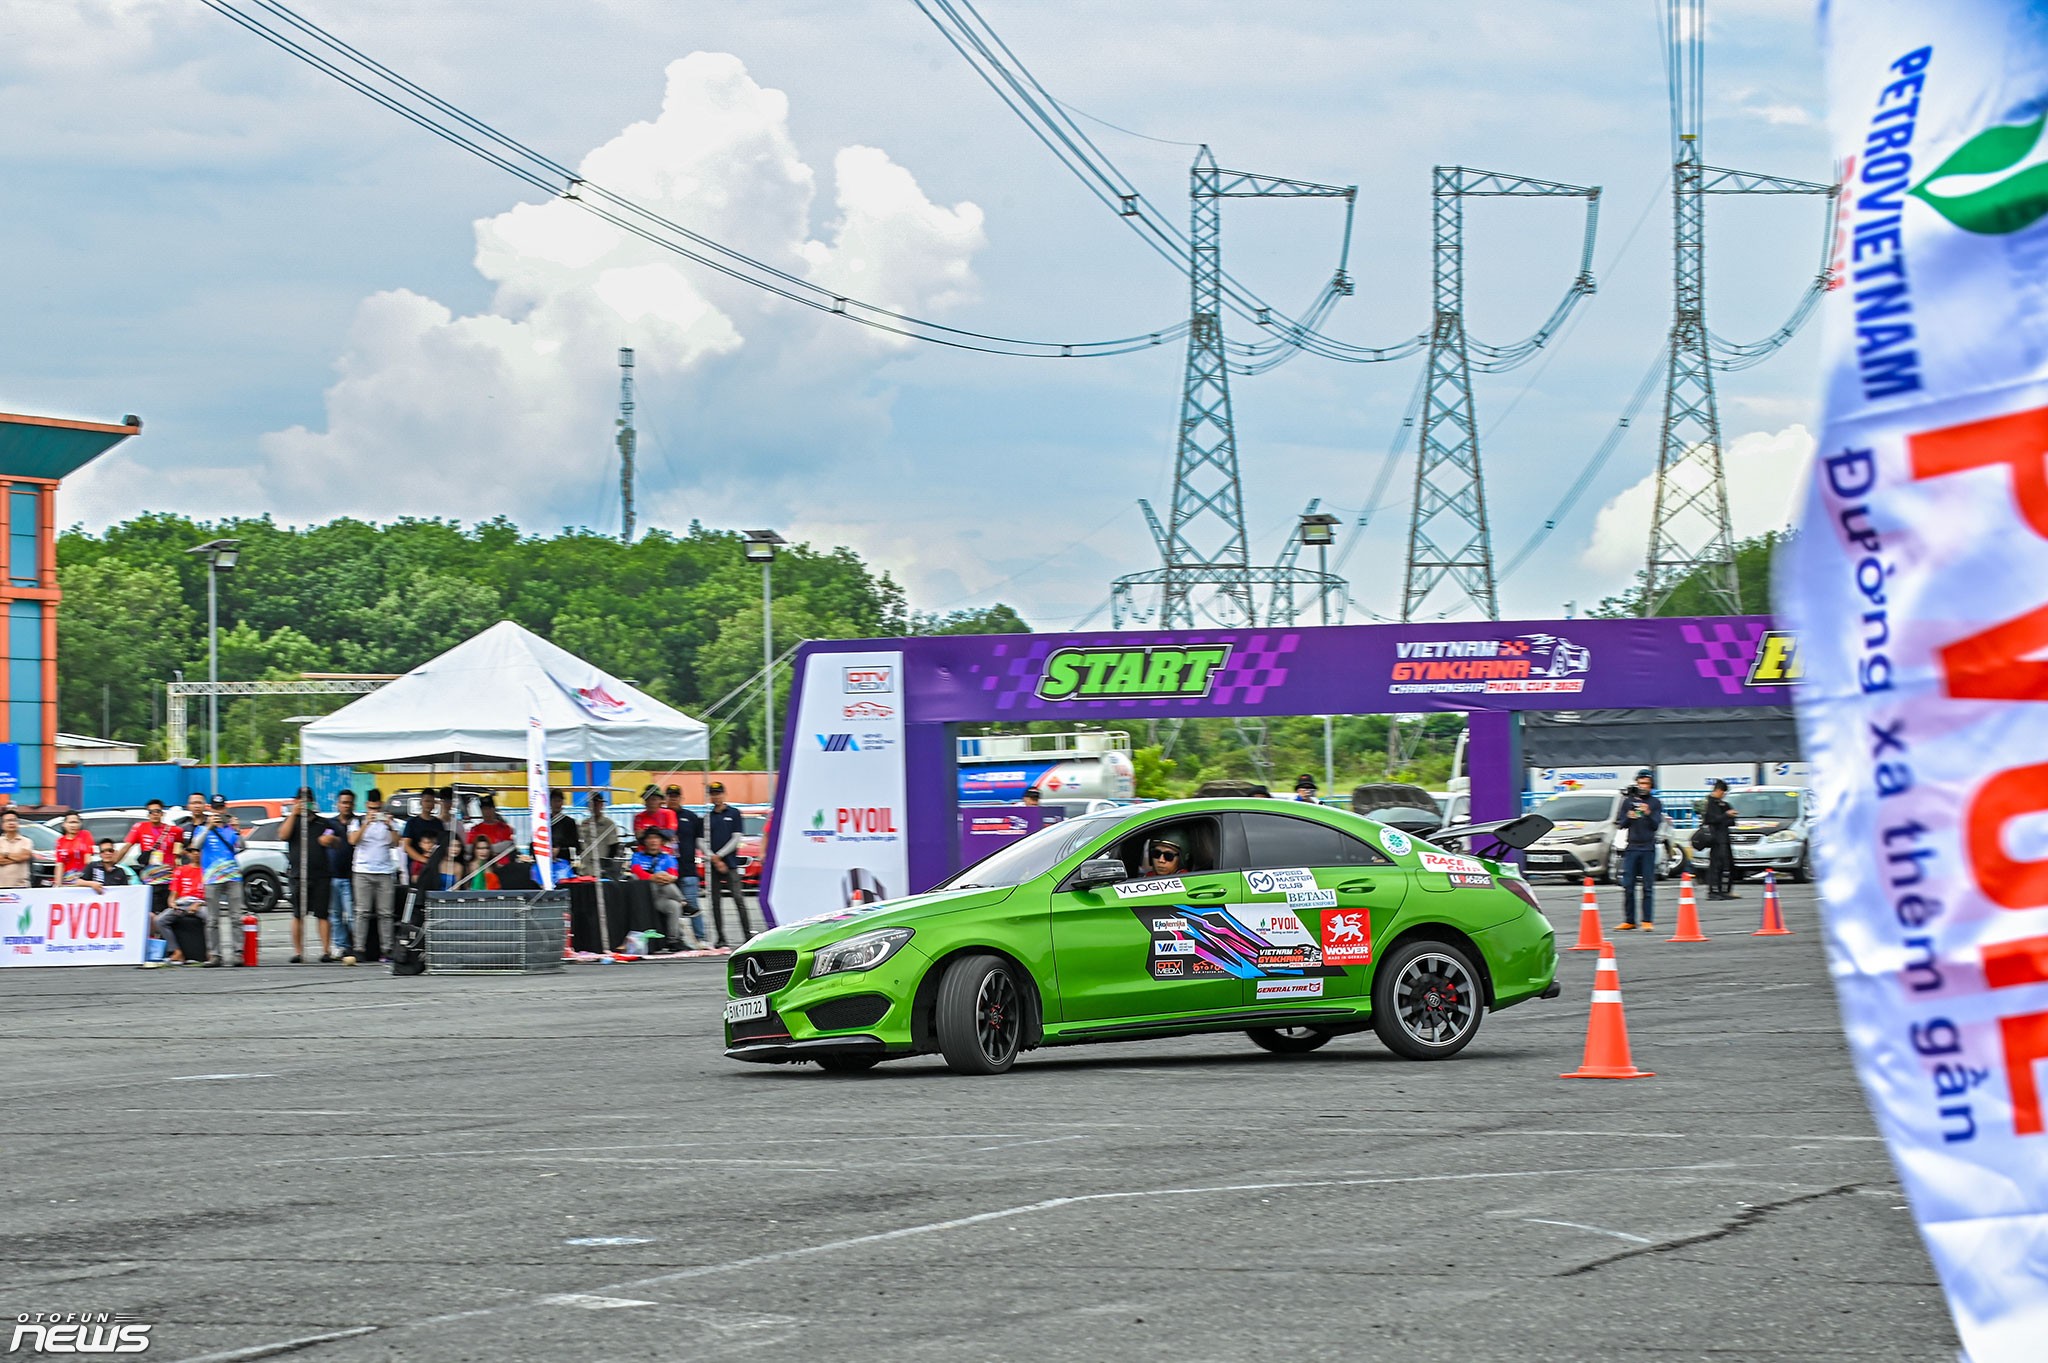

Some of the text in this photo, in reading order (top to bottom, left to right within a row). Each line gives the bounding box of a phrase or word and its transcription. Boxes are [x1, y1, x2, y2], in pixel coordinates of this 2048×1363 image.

[1852, 45, 1933, 400] PETROVIETNAM
[1395, 641, 1499, 658] VIETNAM
[1041, 649, 1227, 696] START
[1391, 660, 1531, 681] GYMKHANA
[1388, 682, 1486, 694] CHAMPIONSHIP
[1527, 681, 1550, 691] CUP
[1870, 718, 1914, 798] xa
[836, 807, 898, 833] PVOIL
[1425, 854, 1465, 866] RACE
[1447, 865, 1481, 873] CHIP
[1289, 891, 1334, 902] BETANI
[1882, 818, 1944, 992] thêm
[48, 902, 125, 940] PVOIL
[1271, 917, 1299, 930] PVOIL
[1259, 948, 1293, 956] VIETNAM
[1324, 944, 1369, 955] WOLVER
[1258, 955, 1304, 963] GYMKHANA
